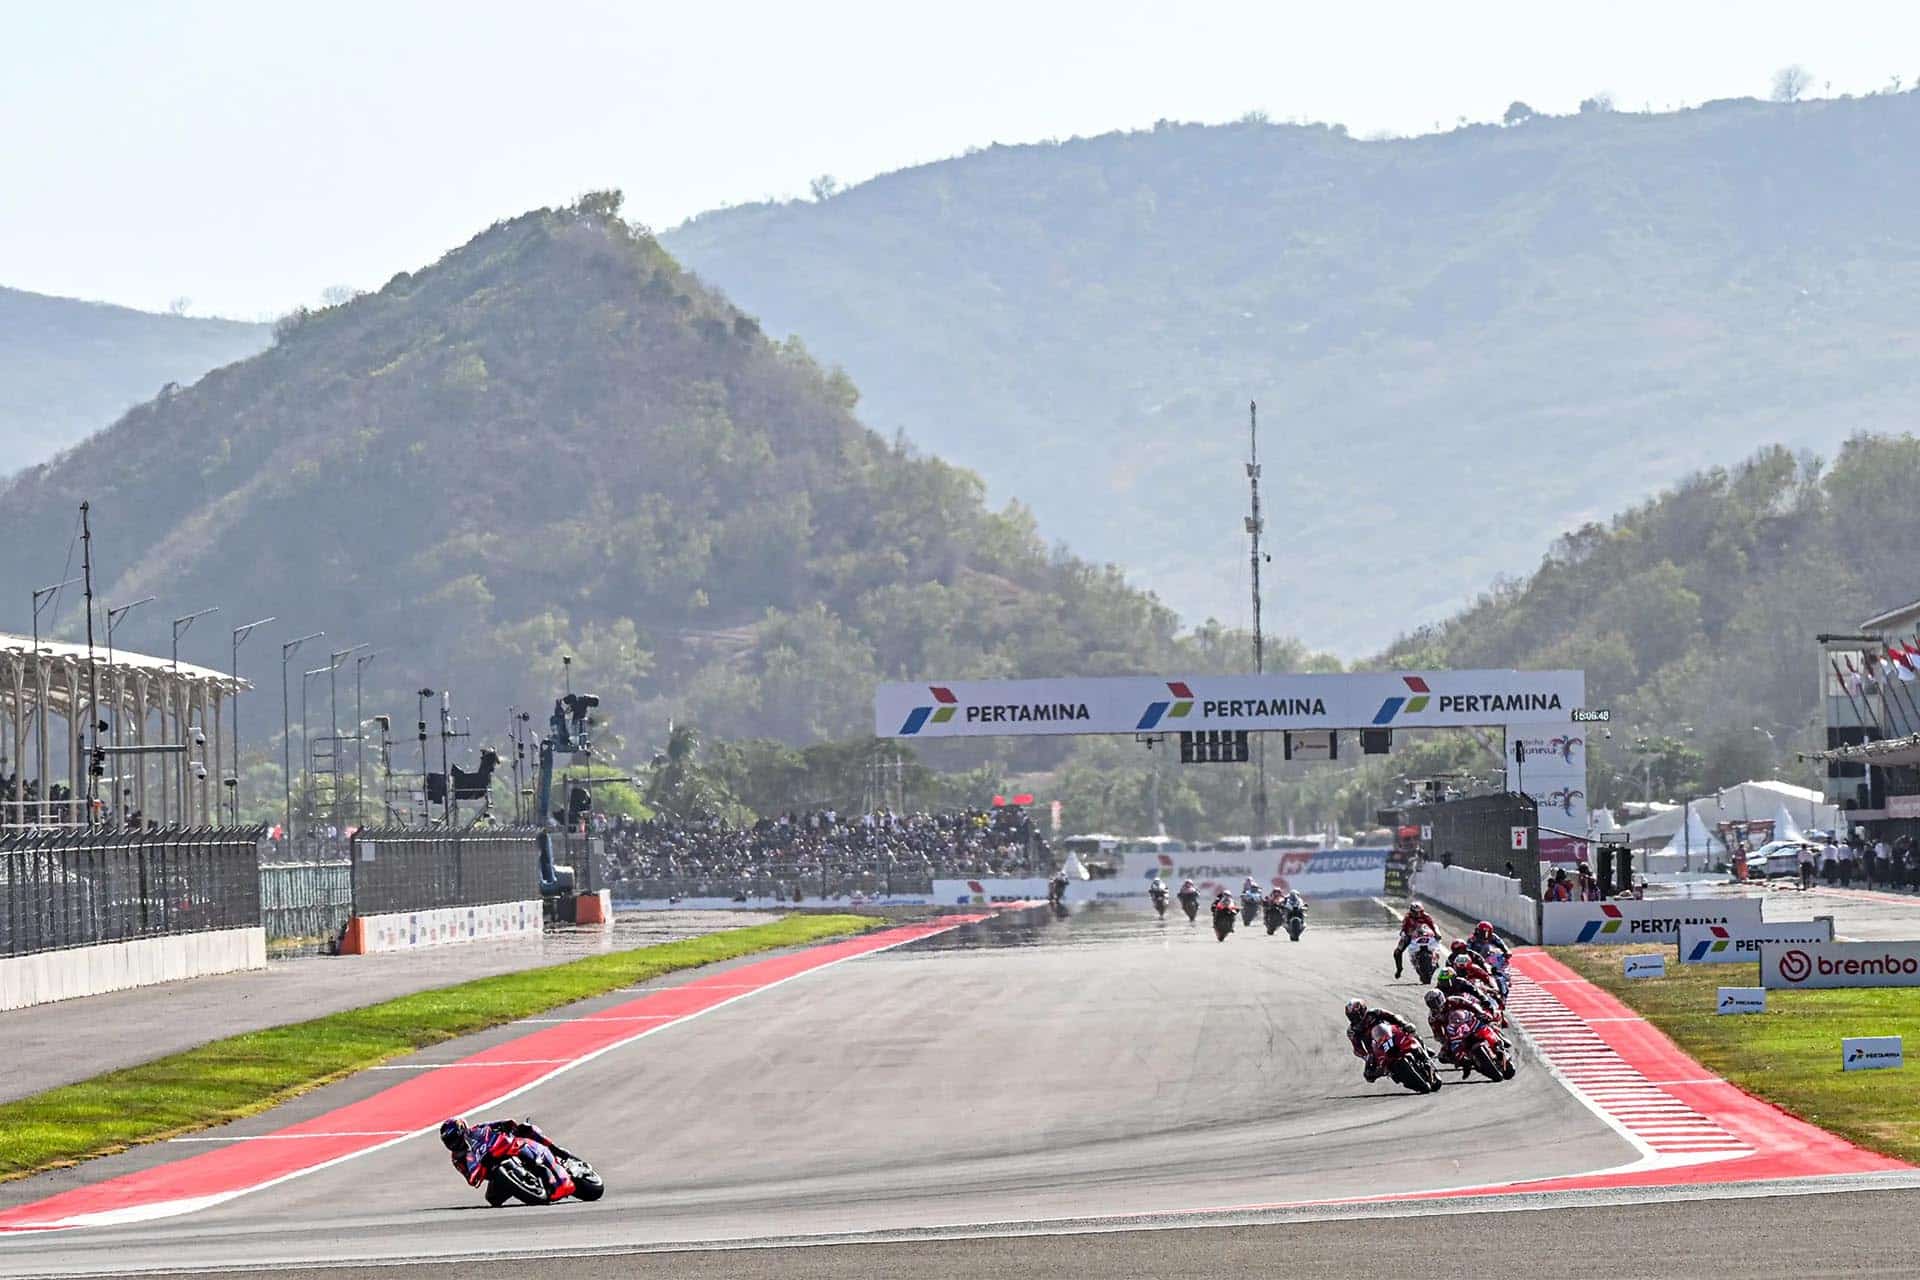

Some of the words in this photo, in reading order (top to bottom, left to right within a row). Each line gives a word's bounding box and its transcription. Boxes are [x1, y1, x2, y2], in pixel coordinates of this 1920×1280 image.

[1203, 698, 1326, 717] PERTAMINA
[1439, 694, 1562, 712] PERTAMINA
[966, 704, 1090, 722] PERTAMINA
[1818, 954, 1918, 975] brembo
